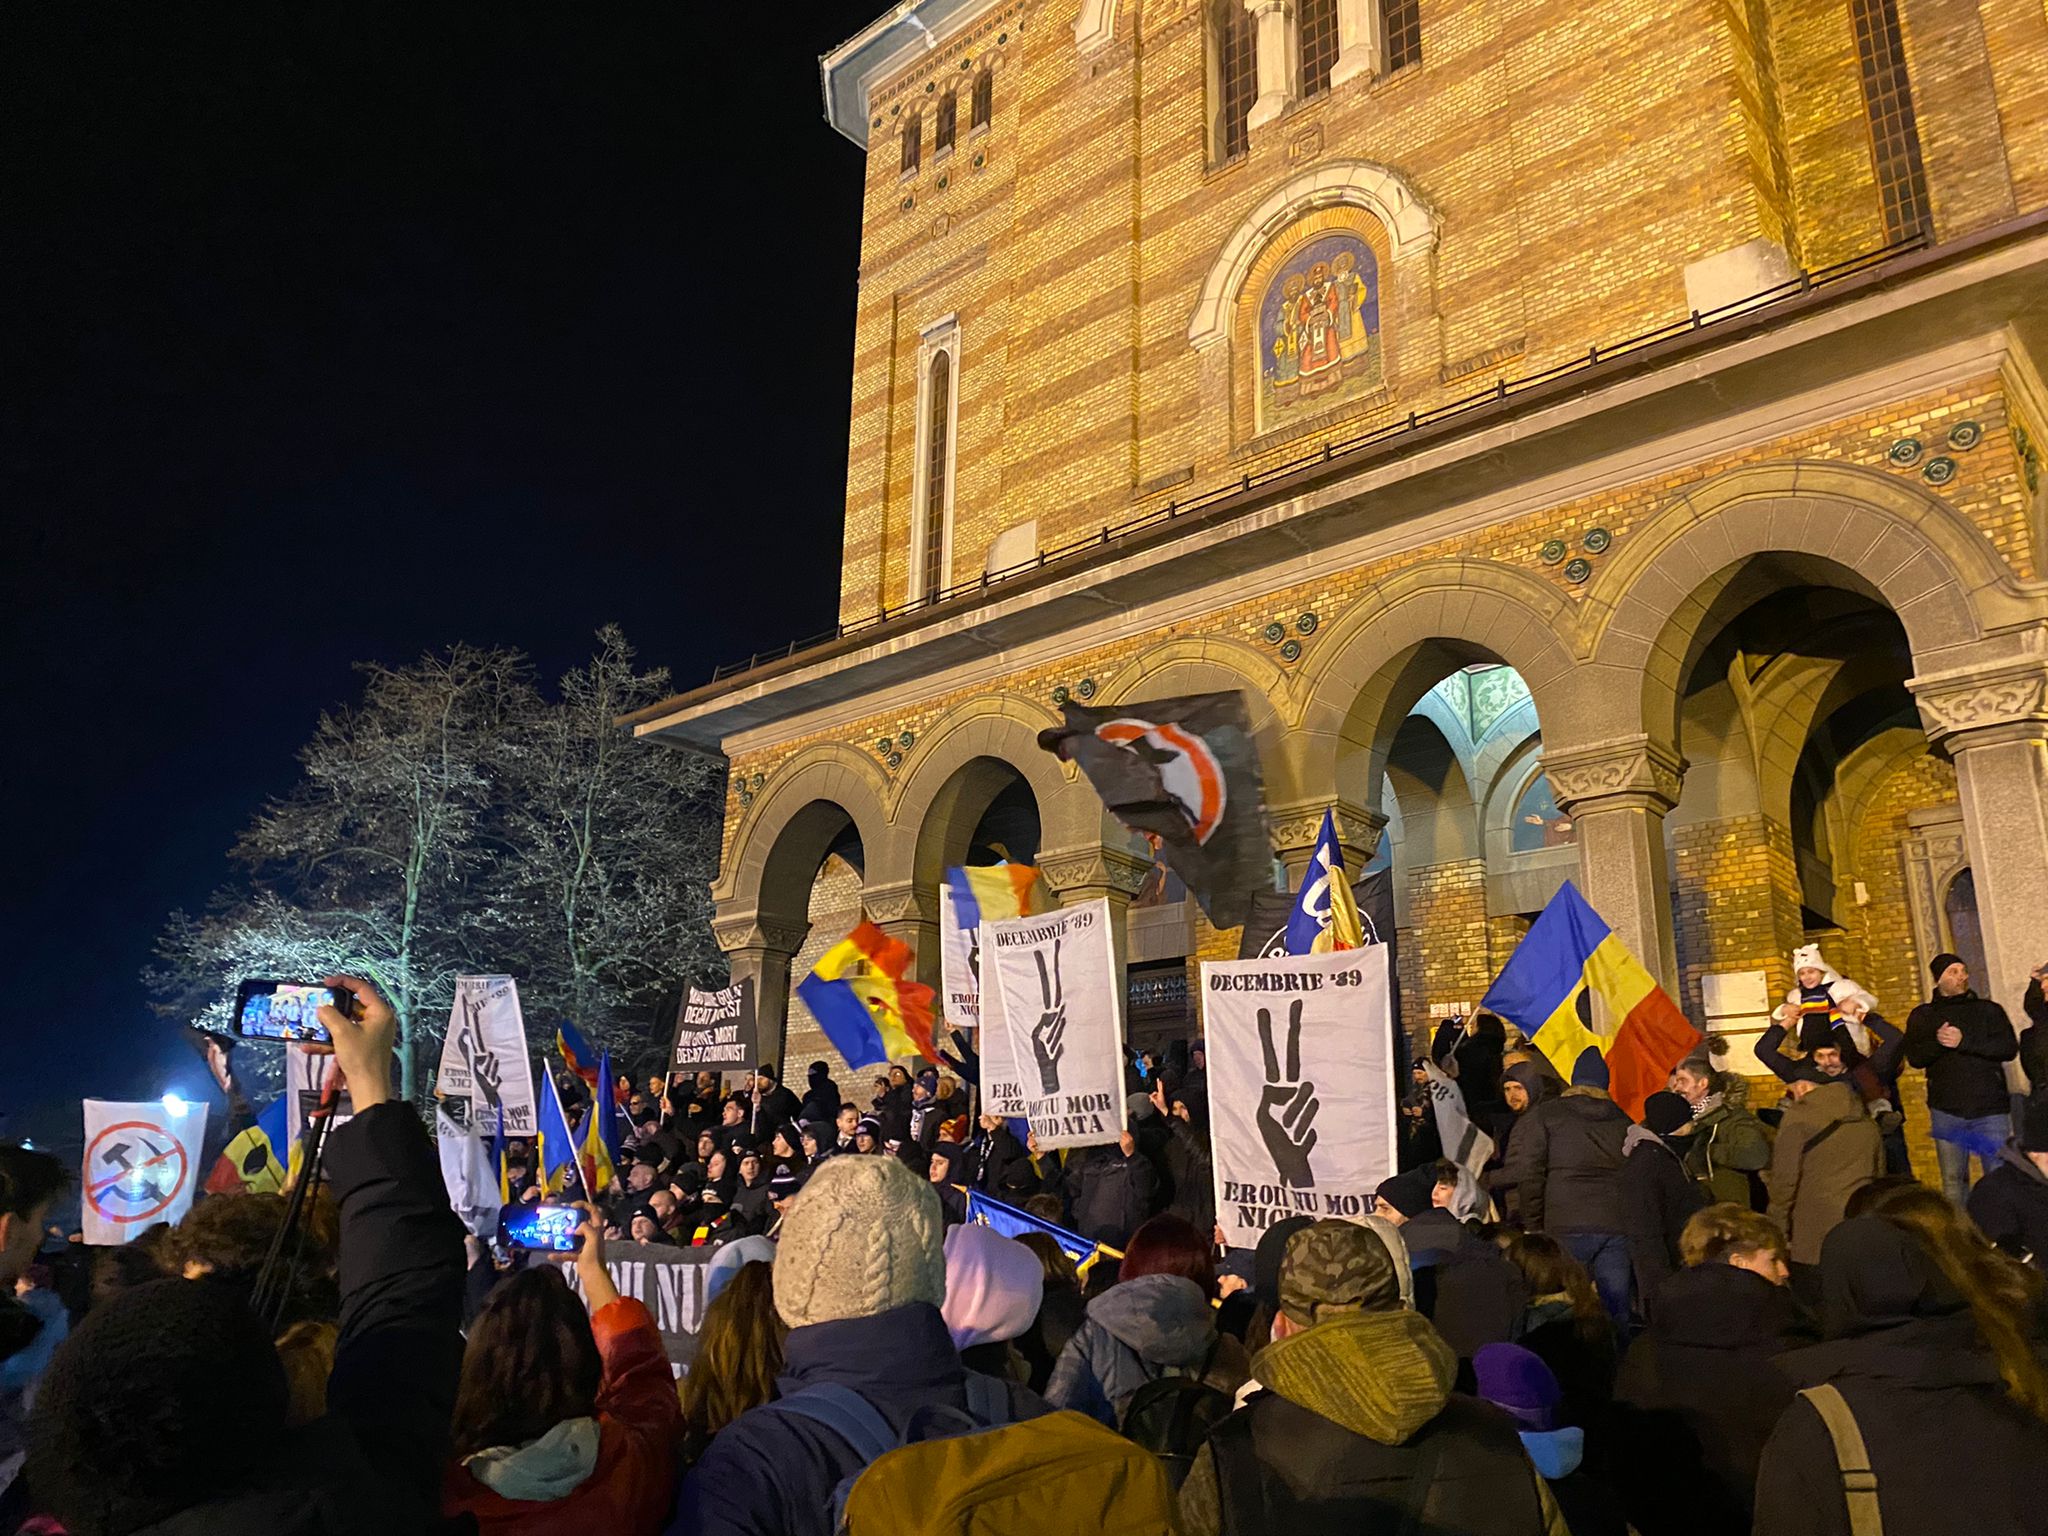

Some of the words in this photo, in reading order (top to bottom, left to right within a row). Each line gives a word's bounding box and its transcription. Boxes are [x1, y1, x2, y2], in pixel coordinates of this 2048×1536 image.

[996, 919, 1068, 947] DECEMBRIE
[1210, 973, 1323, 992] DECEMBRIE
[1330, 969, 1363, 987] '89
[1066, 1093, 1112, 1114] MOR
[1224, 1181, 1289, 1207] EROII
[1292, 1190, 1319, 1212] NU
